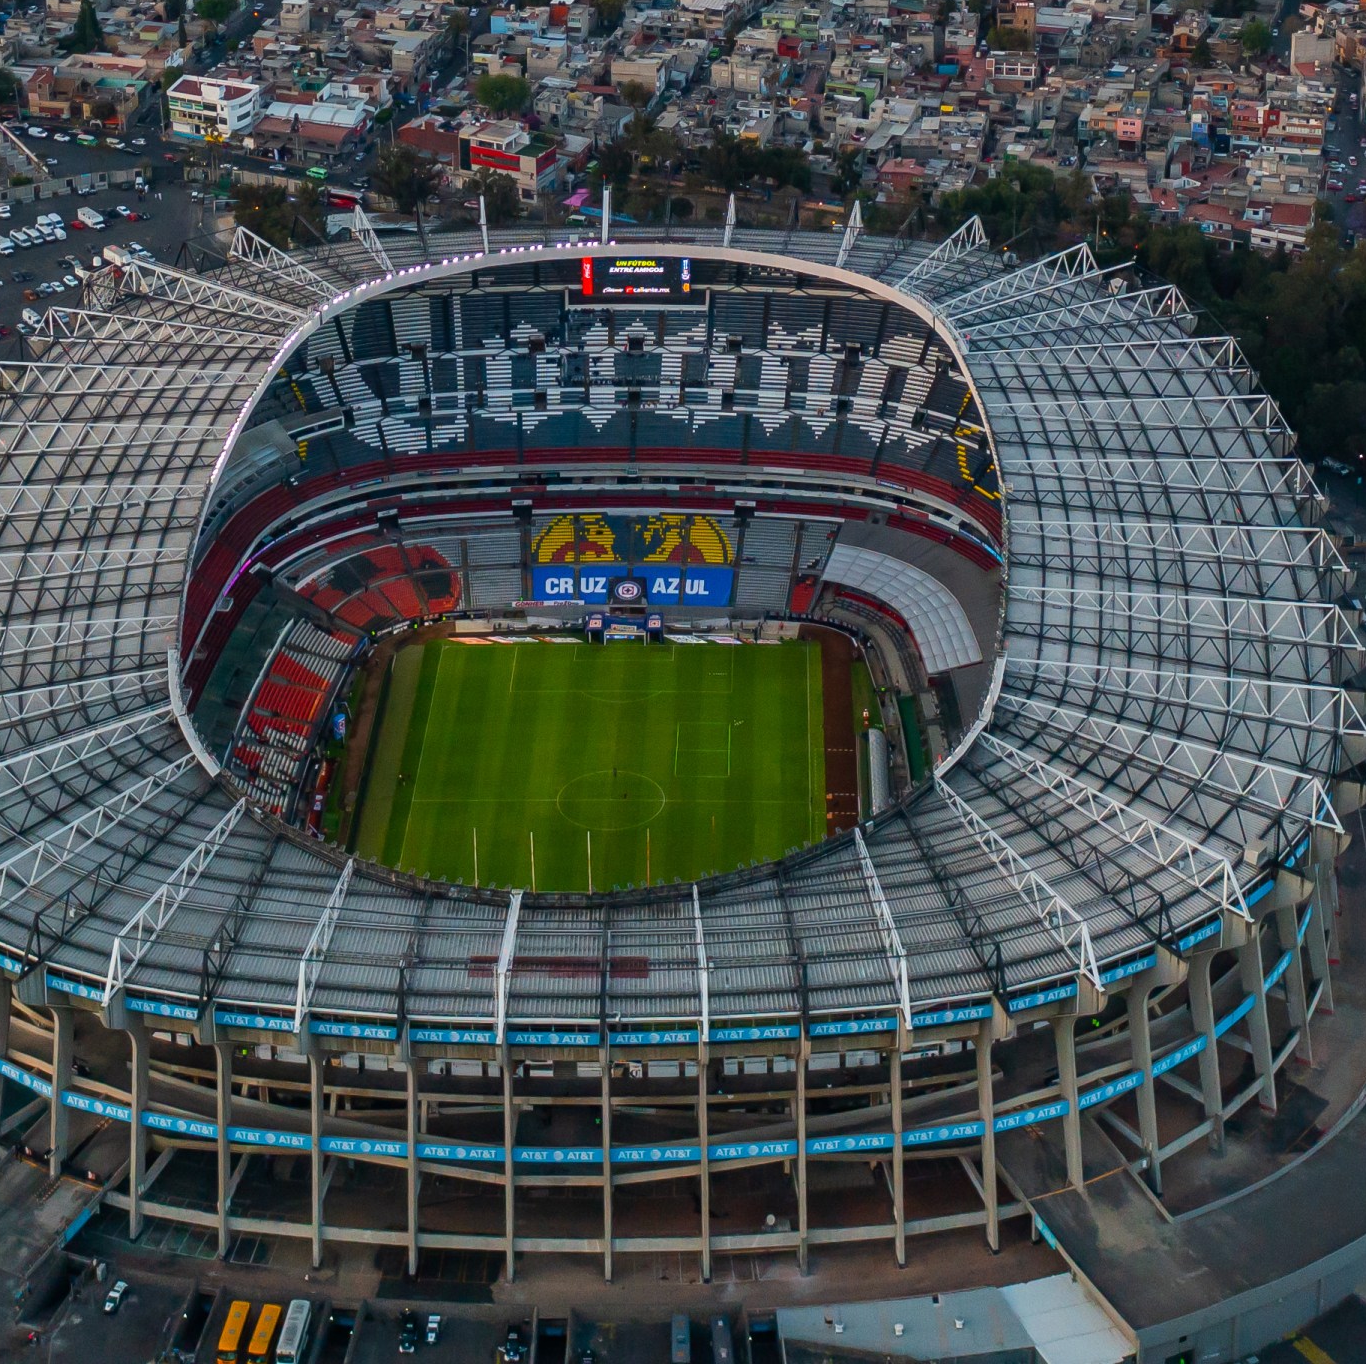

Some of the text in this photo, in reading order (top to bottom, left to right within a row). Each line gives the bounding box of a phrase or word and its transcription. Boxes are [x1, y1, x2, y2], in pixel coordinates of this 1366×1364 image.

[1126, 959, 1148, 974] AT&T
[1047, 987, 1072, 1001] AT&T
[131, 1000, 198, 1020] AT&T AT&T
[912, 1008, 984, 1025] AT&T AT&T
[223, 1014, 294, 1030] AT&T AT&T
[815, 1020, 889, 1034] AT&T AT&T
[318, 1024, 392, 1038] AT&T AT&T
[416, 1031, 491, 1043] AT&T AT&T
[616, 1032, 691, 1044] AT&T AT&T
[716, 1027, 791, 1040] AT&T AT&T
[515, 1034, 591, 1044] AT&T AT&T
[1184, 1041, 1203, 1056] AT&T
[1080, 1077, 1138, 1107] AT&T AT&T
[66, 1095, 130, 1119] AT&T AT&T
[996, 1105, 1062, 1129] AT&T AT&T
[147, 1115, 215, 1135] AT&T AT&T
[235, 1130, 306, 1146] AT&T AT&T
[907, 1125, 978, 1143] AT&T AT&T
[329, 1141, 402, 1154] AT&T AT&T
[715, 1143, 790, 1157] AT&T AT&T
[812, 1136, 885, 1151] AT&T AT&T
[423, 1146, 497, 1159] AT&T AT&T
[521, 1151, 595, 1161] AT&T AT&T
[618, 1149, 692, 1160] AT&T AT&T
